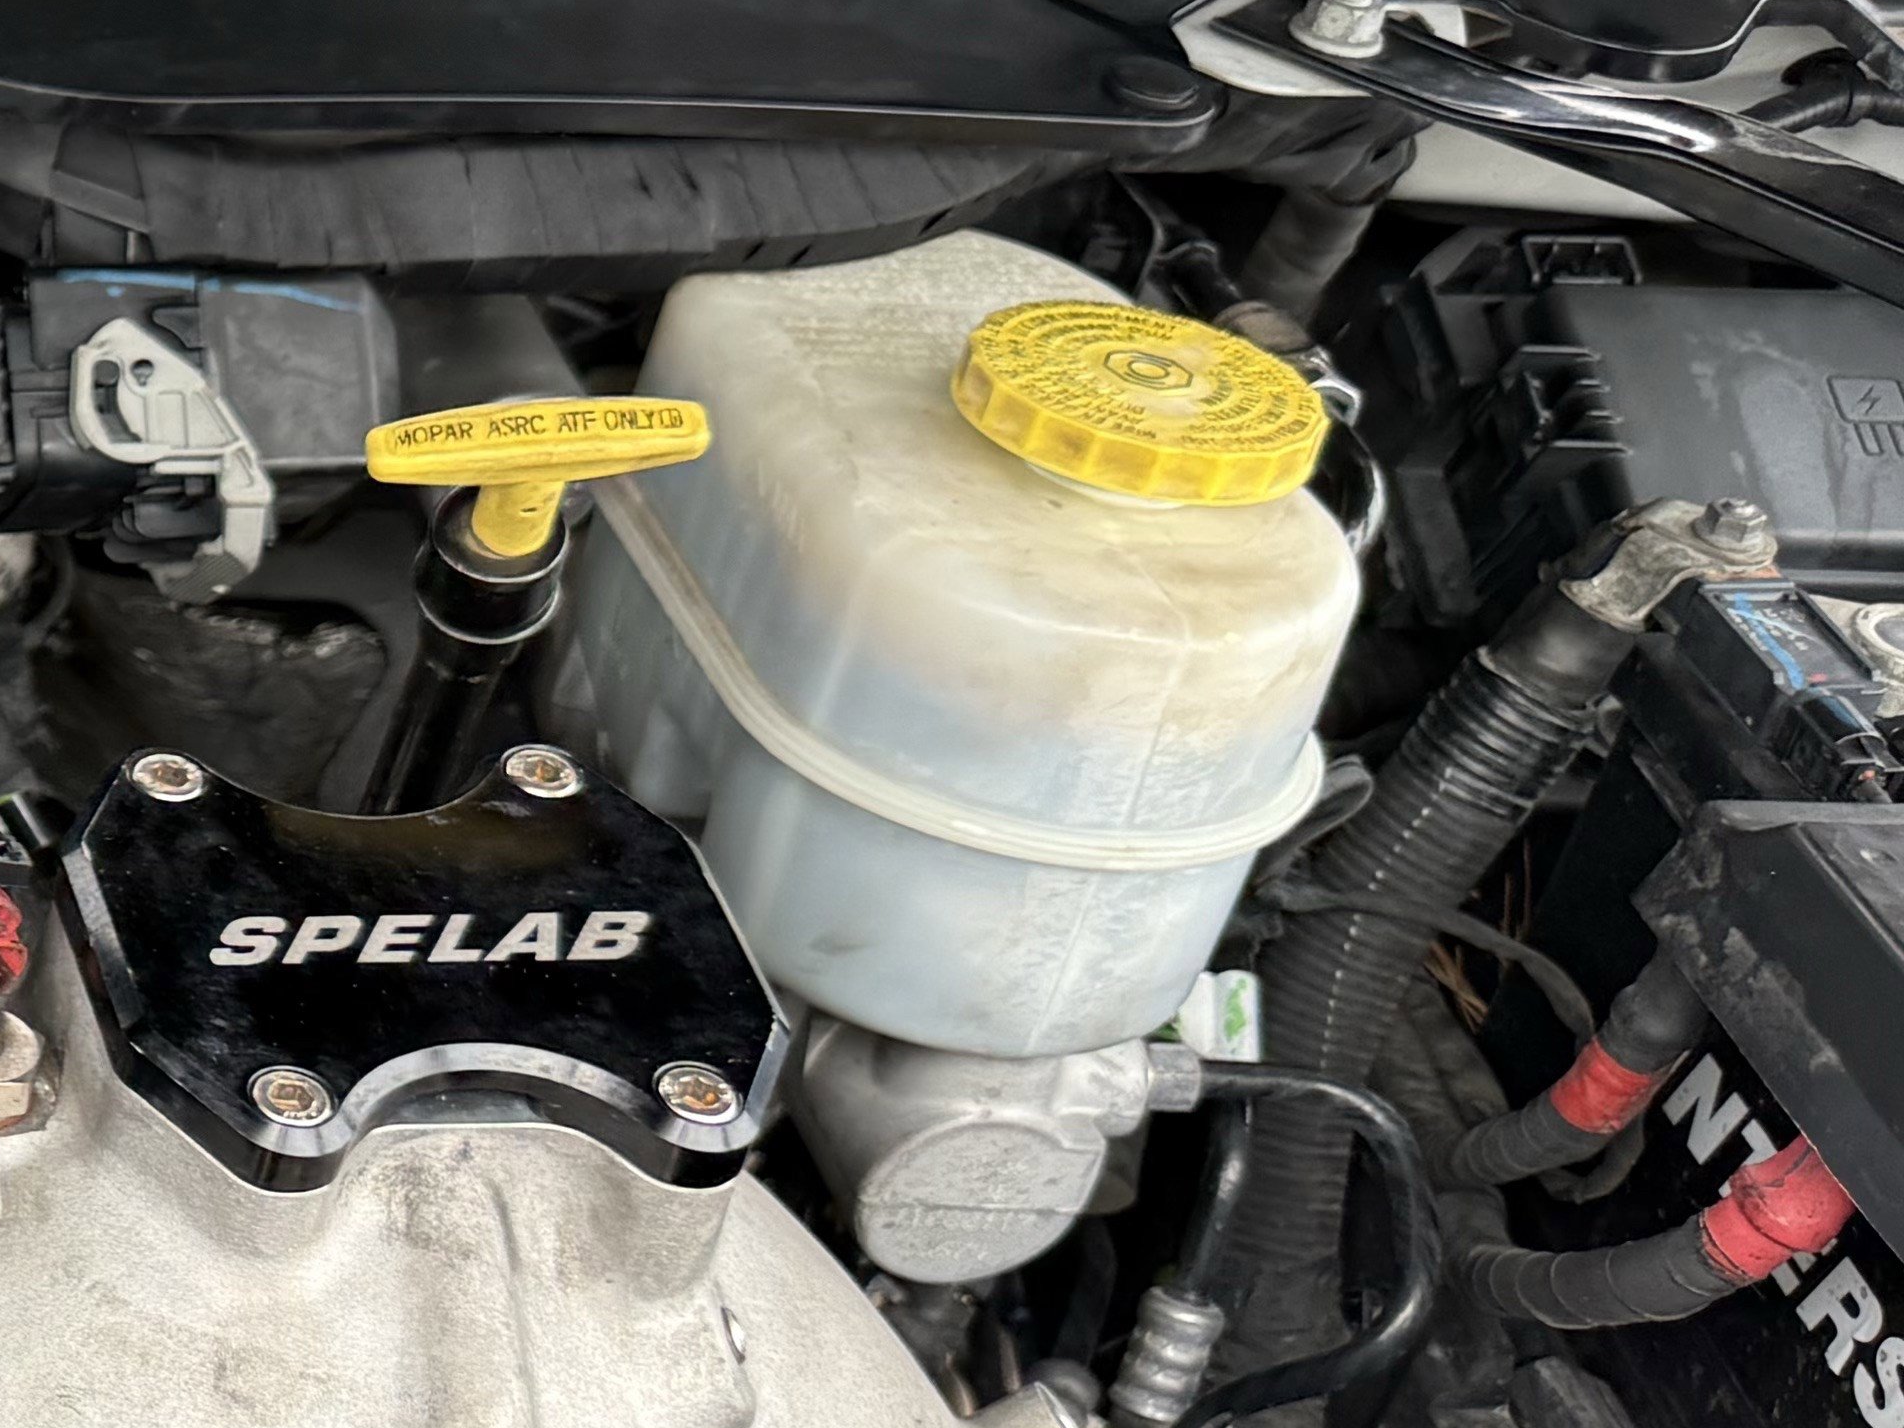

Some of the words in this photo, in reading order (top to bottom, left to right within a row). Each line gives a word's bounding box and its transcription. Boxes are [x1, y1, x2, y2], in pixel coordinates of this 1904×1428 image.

[393, 421, 473, 450] MOPAR
[487, 414, 547, 438] ASRC
[558, 410, 596, 434] ATF
[604, 408, 655, 432] ONLY
[208, 910, 653, 967] SPELAB
